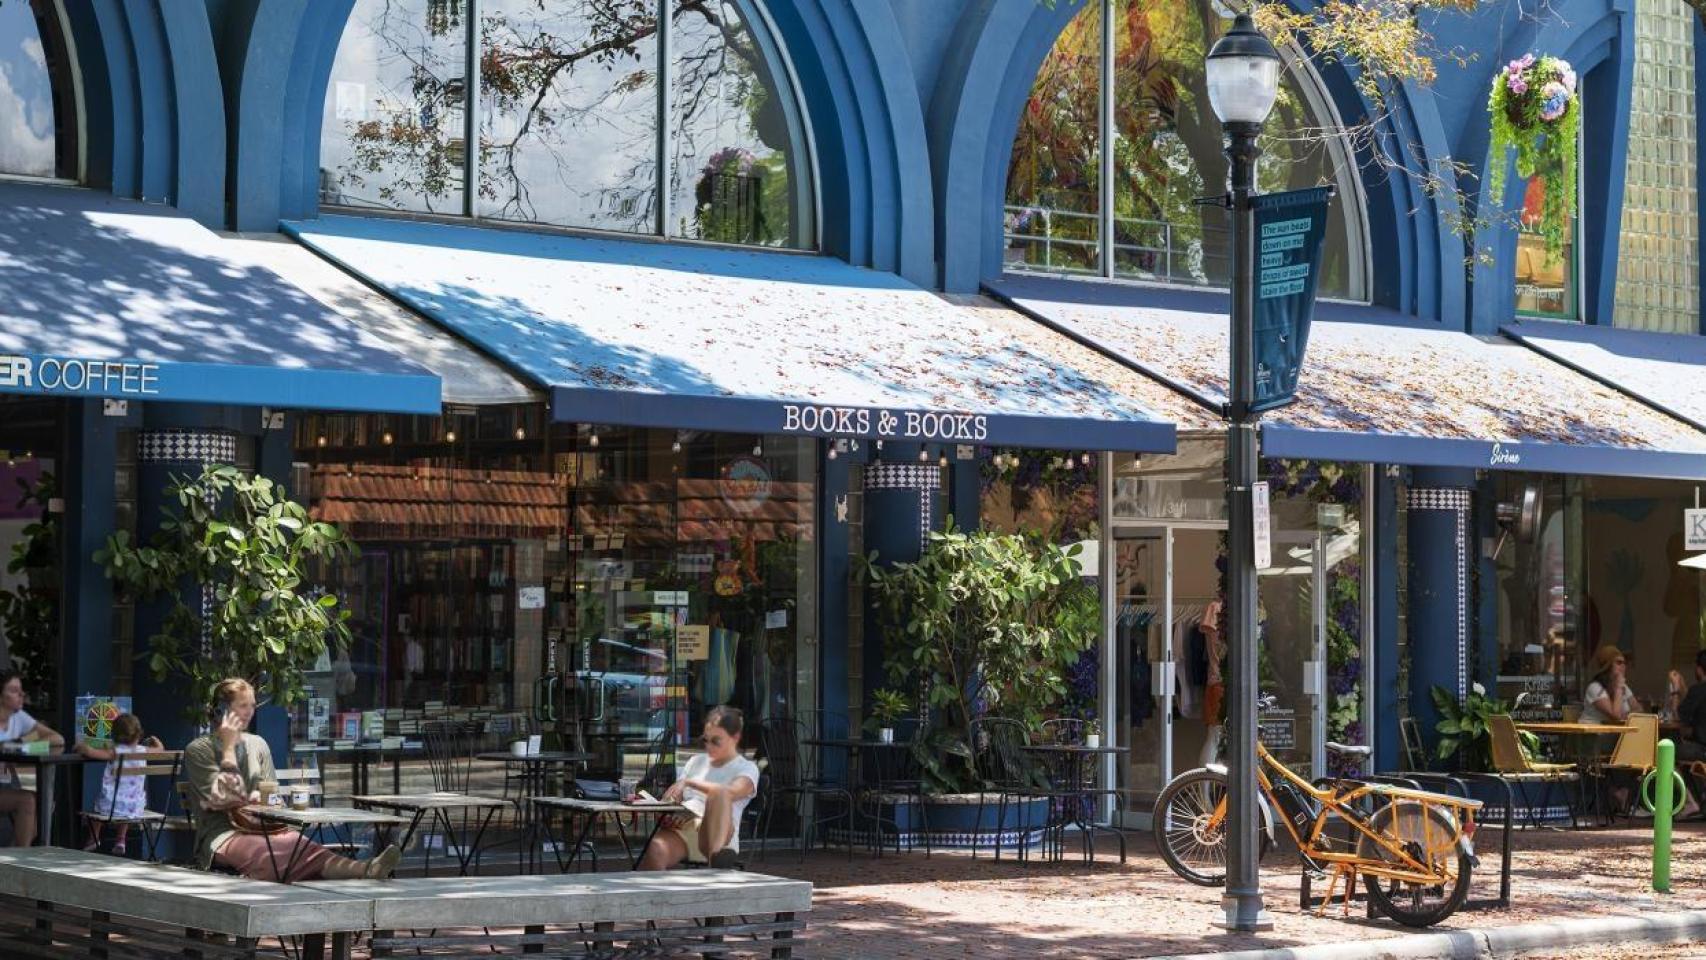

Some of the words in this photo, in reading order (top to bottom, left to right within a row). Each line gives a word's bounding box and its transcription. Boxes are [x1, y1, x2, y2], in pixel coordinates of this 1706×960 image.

[1263, 225, 1276, 235] The
[1263, 240, 1281, 250] down
[38, 358, 160, 394] COFFEE
[782, 405, 870, 434] BOOKS
[878, 409, 898, 436] &
[905, 411, 987, 440] BOOKS
